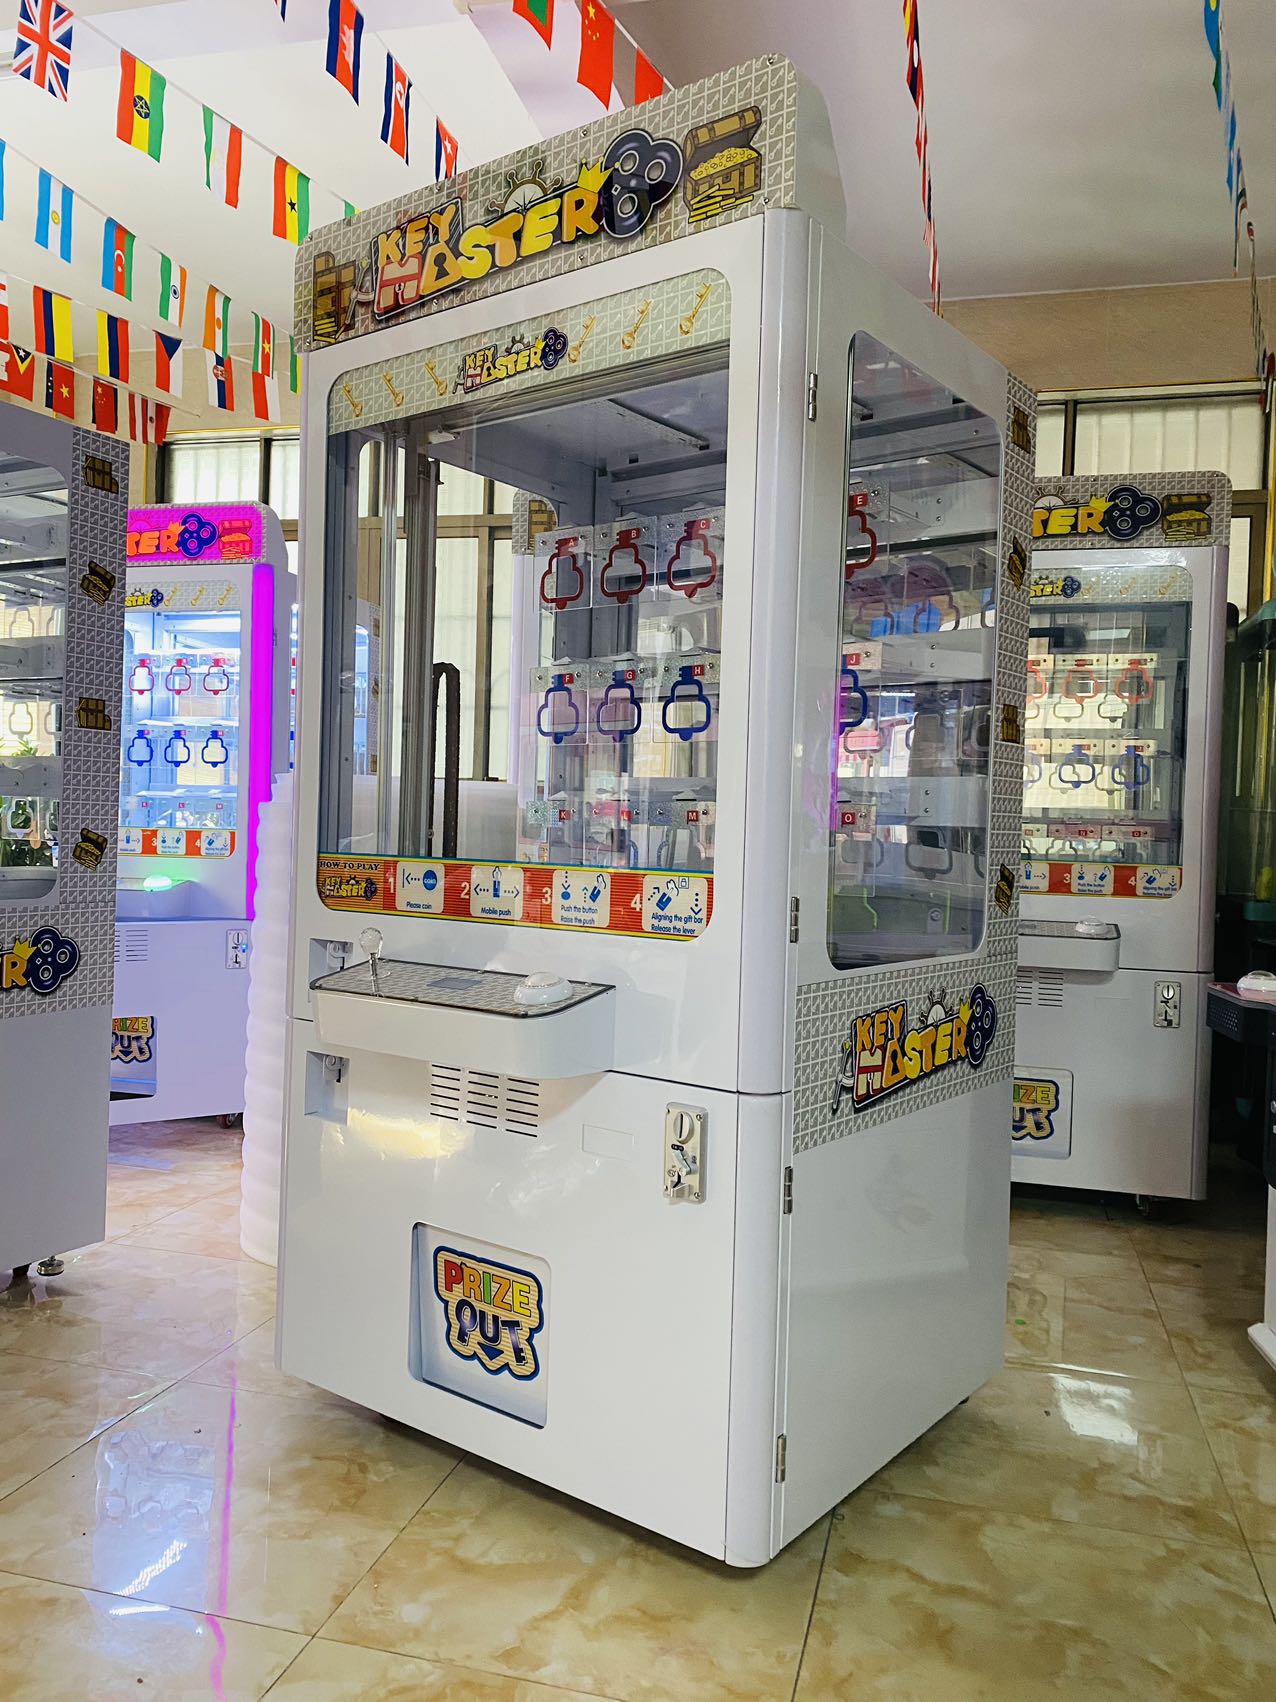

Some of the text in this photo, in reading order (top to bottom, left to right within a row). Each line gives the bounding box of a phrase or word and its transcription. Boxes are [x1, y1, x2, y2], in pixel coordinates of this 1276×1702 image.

[377, 203, 457, 267] KEY
[375, 187, 600, 313] MASTER
[465, 347, 496, 369] KEY
[465, 347, 543, 389] MASTER
[857, 495, 863, 505] E
[699, 520, 707, 528] C
[631, 530, 637, 538] B
[626, 671, 633, 679] G
[694, 666, 701, 674] H
[688, 811, 697, 820] M
[319, 861, 381, 871] HOW TO PLAY
[325, 876, 341, 886] KEY
[1063, 873, 1071, 883] 3
[1127, 876, 1136, 886] 4
[388, 876, 395, 894] 1
[460, 882, 470, 899] 2
[542, 887, 552, 905] 3
[406, 901, 433, 910] Please coin
[631, 893, 642, 912] 4
[480, 906, 512, 917] Mobile push
[560, 904, 598, 915] Push the button
[560, 914, 595, 926] Raise the push
[651, 912, 673, 923] Aligning
[673, 913, 683, 923] the
[683, 914, 693, 924] gift
[651, 923, 696, 935] Release the lever
[856, 1005, 904, 1052] KEY
[854, 1017, 968, 1100] MASTER
[443, 1258, 532, 1318] PRIZE
[454, 1298, 528, 1366] OUT
